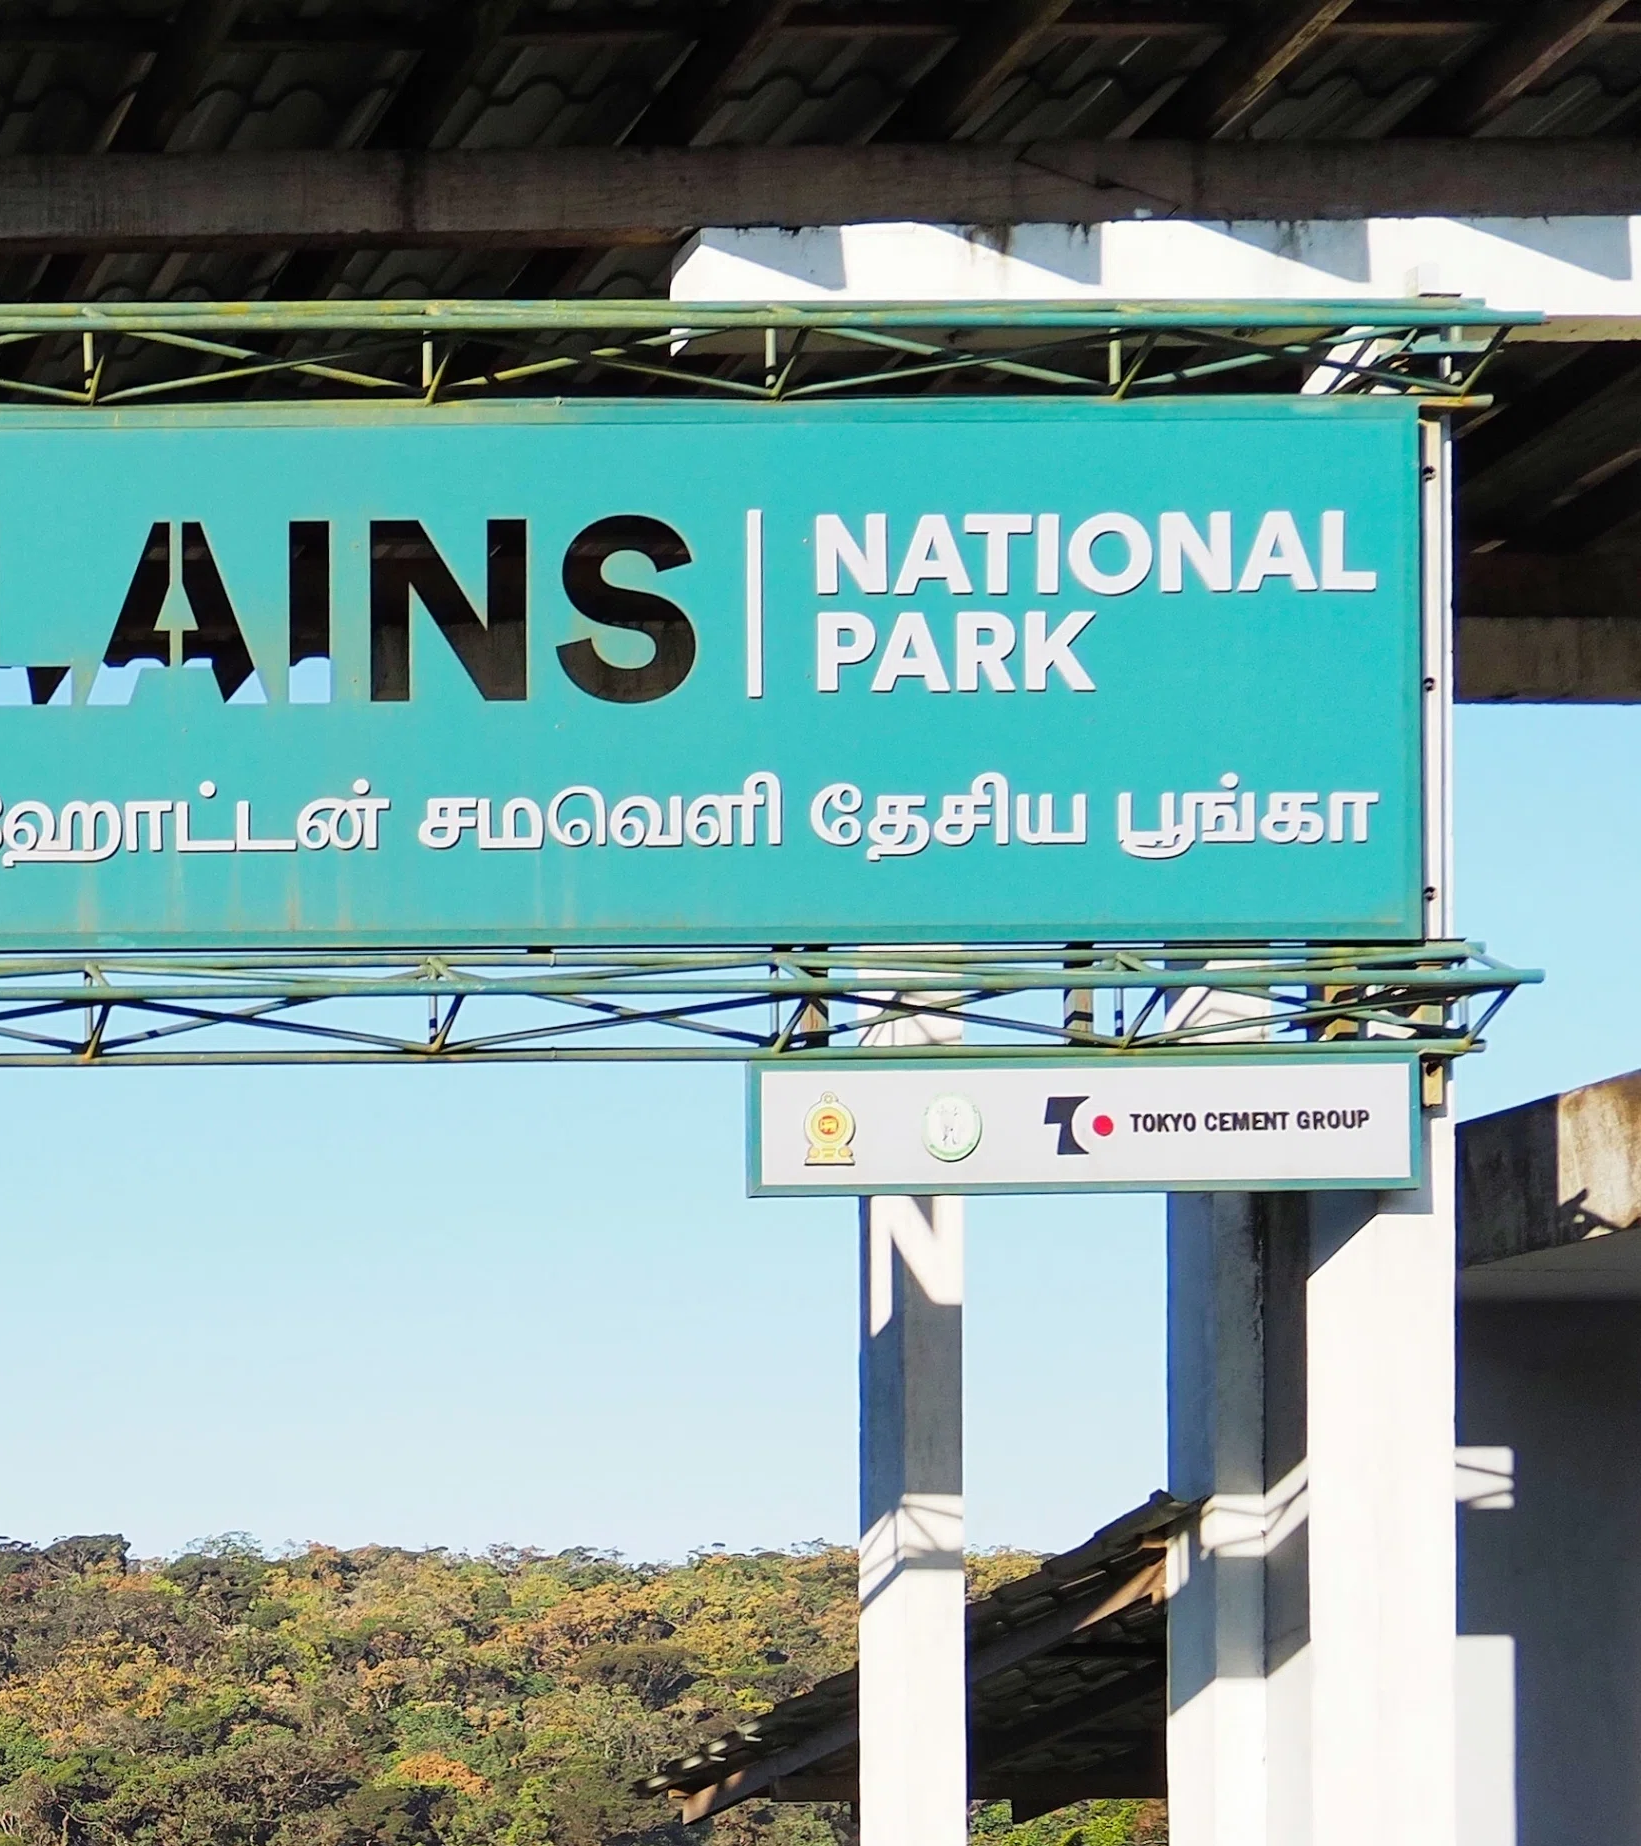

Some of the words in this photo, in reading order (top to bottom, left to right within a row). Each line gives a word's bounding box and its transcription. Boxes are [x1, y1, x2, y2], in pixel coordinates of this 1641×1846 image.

[816, 510, 1377, 595] NATIONAL
[816, 610, 1097, 692] PARK
[418, 771, 781, 849] சமவெளி
[810, 772, 1087, 861] தேசிய
[1117, 773, 1380, 859] பூங்கா
[1129, 1111, 1197, 1134] TOKYO
[1204, 1110, 1290, 1133] CEMENT
[1296, 1108, 1371, 1132] GROUP
